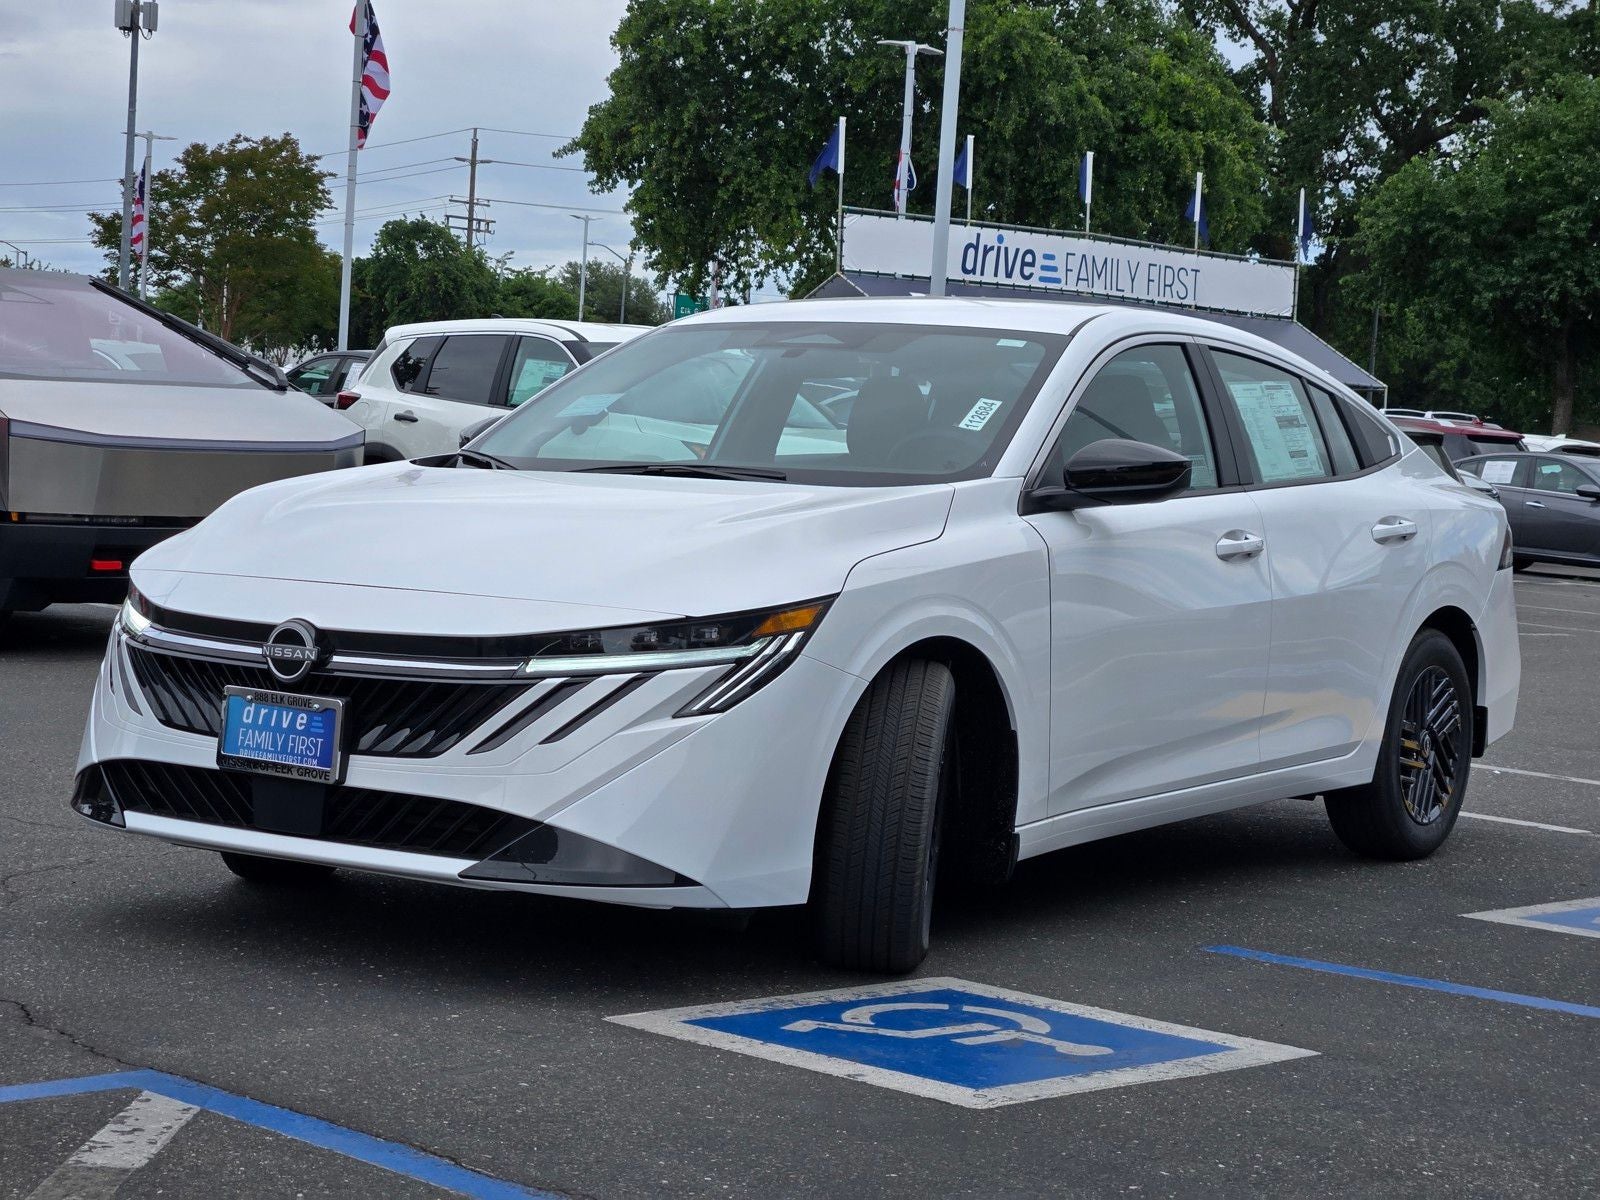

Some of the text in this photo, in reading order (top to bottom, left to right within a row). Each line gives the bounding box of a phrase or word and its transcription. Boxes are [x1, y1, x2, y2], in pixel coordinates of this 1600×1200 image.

[961, 233, 1201, 301] drive FAMILY FIRST
[965, 401, 997, 427] 112684
[263, 646, 316, 659] NISSAN
[270, 693, 285, 704] ELK
[287, 696, 313, 708] GROVE
[242, 703, 308, 730] drive
[238, 728, 324, 757] FAMILY FIRST
[239, 748, 318, 766] DRIVEFAMILYFIRST.COM
[274, 764, 294, 775] ELK
[296, 767, 331, 781] GROVE
